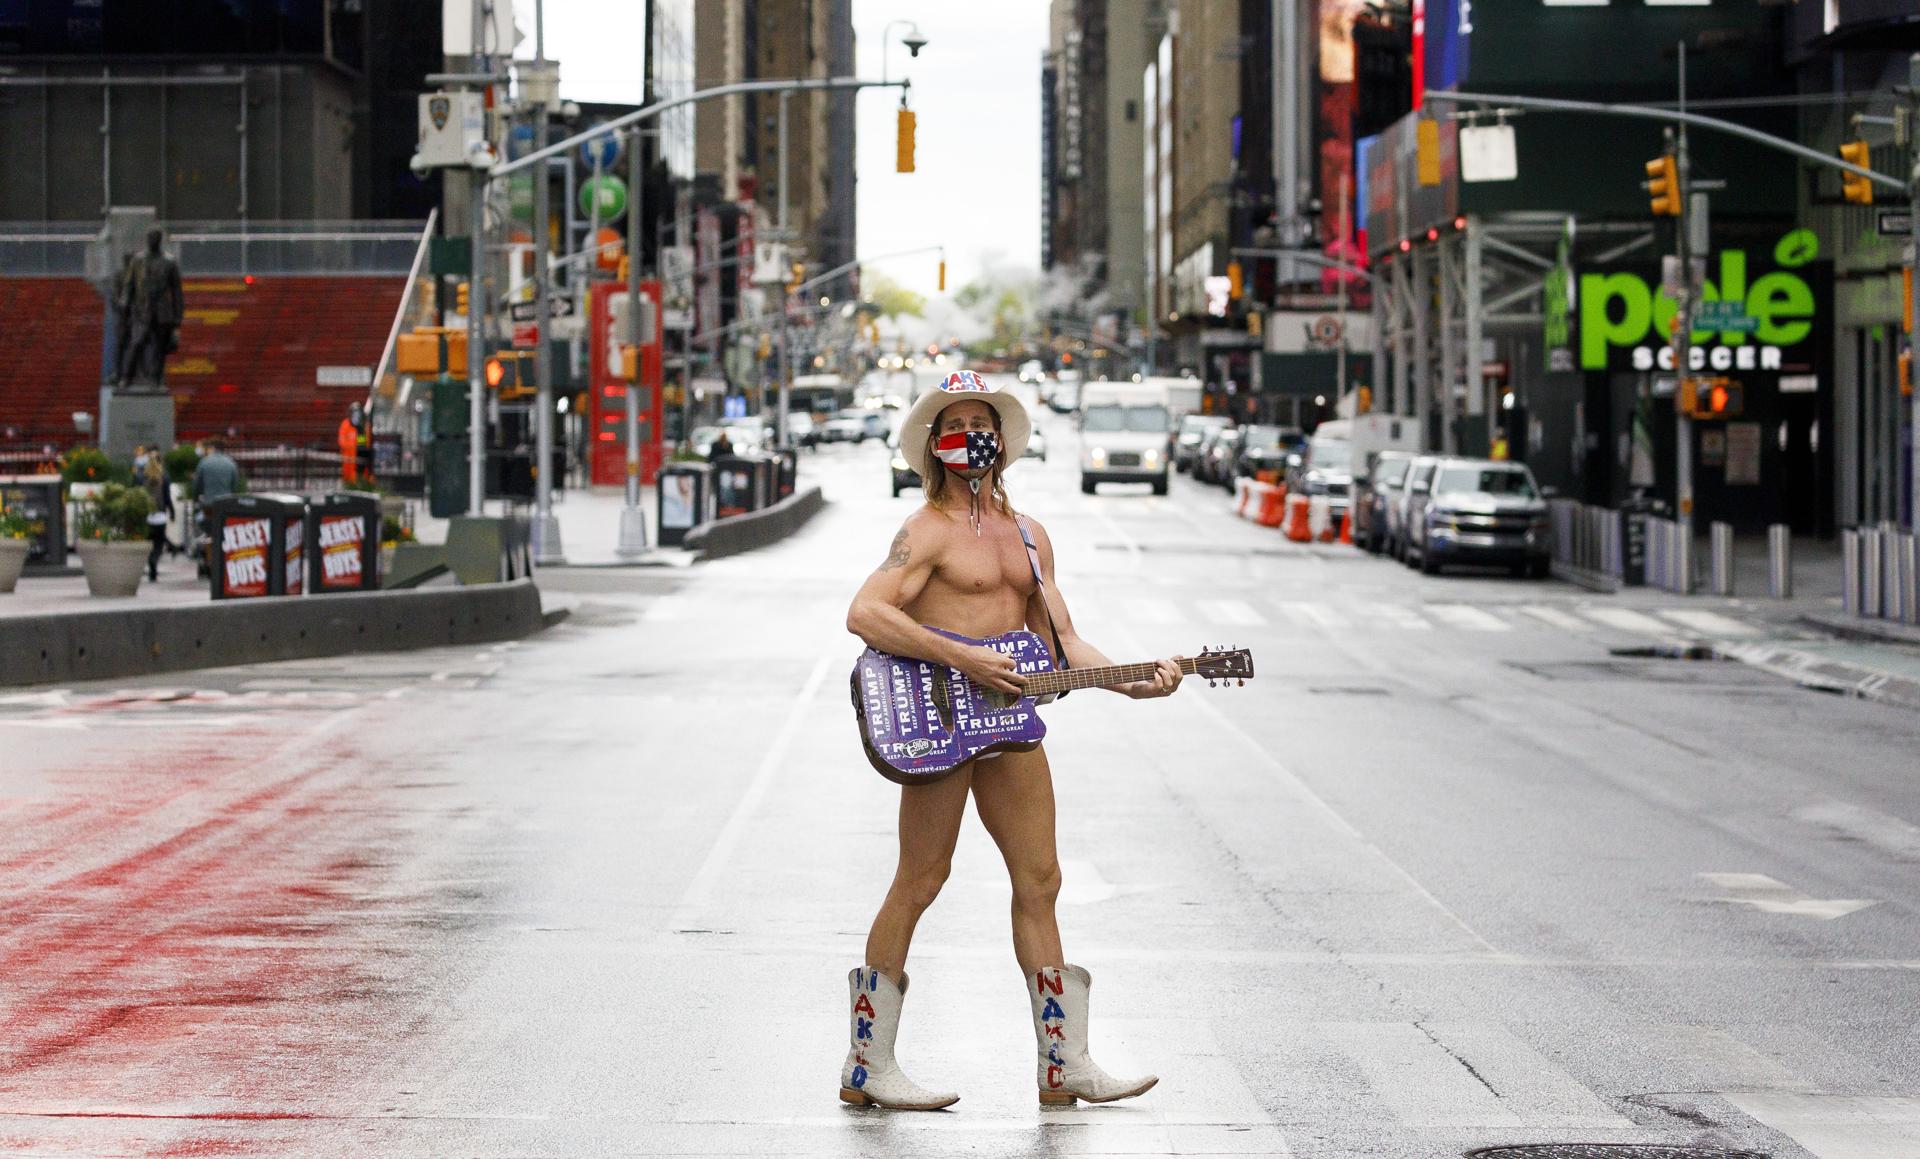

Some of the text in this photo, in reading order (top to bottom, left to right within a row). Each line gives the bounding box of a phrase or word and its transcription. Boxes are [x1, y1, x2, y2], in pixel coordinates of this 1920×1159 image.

[940, 371, 989, 392] NAKE
[222, 517, 271, 552] JERSEY
[319, 515, 365, 548] JERSEY
[226, 555, 267, 588] BOYS
[323, 548, 362, 580] BOYS
[865, 667, 885, 738] TRUMP
[892, 664, 912, 736] TRUMP
[950, 667, 969, 720] TRUM
[956, 713, 1029, 730] TRUMP
[980, 726, 1005, 735] AMERICA
